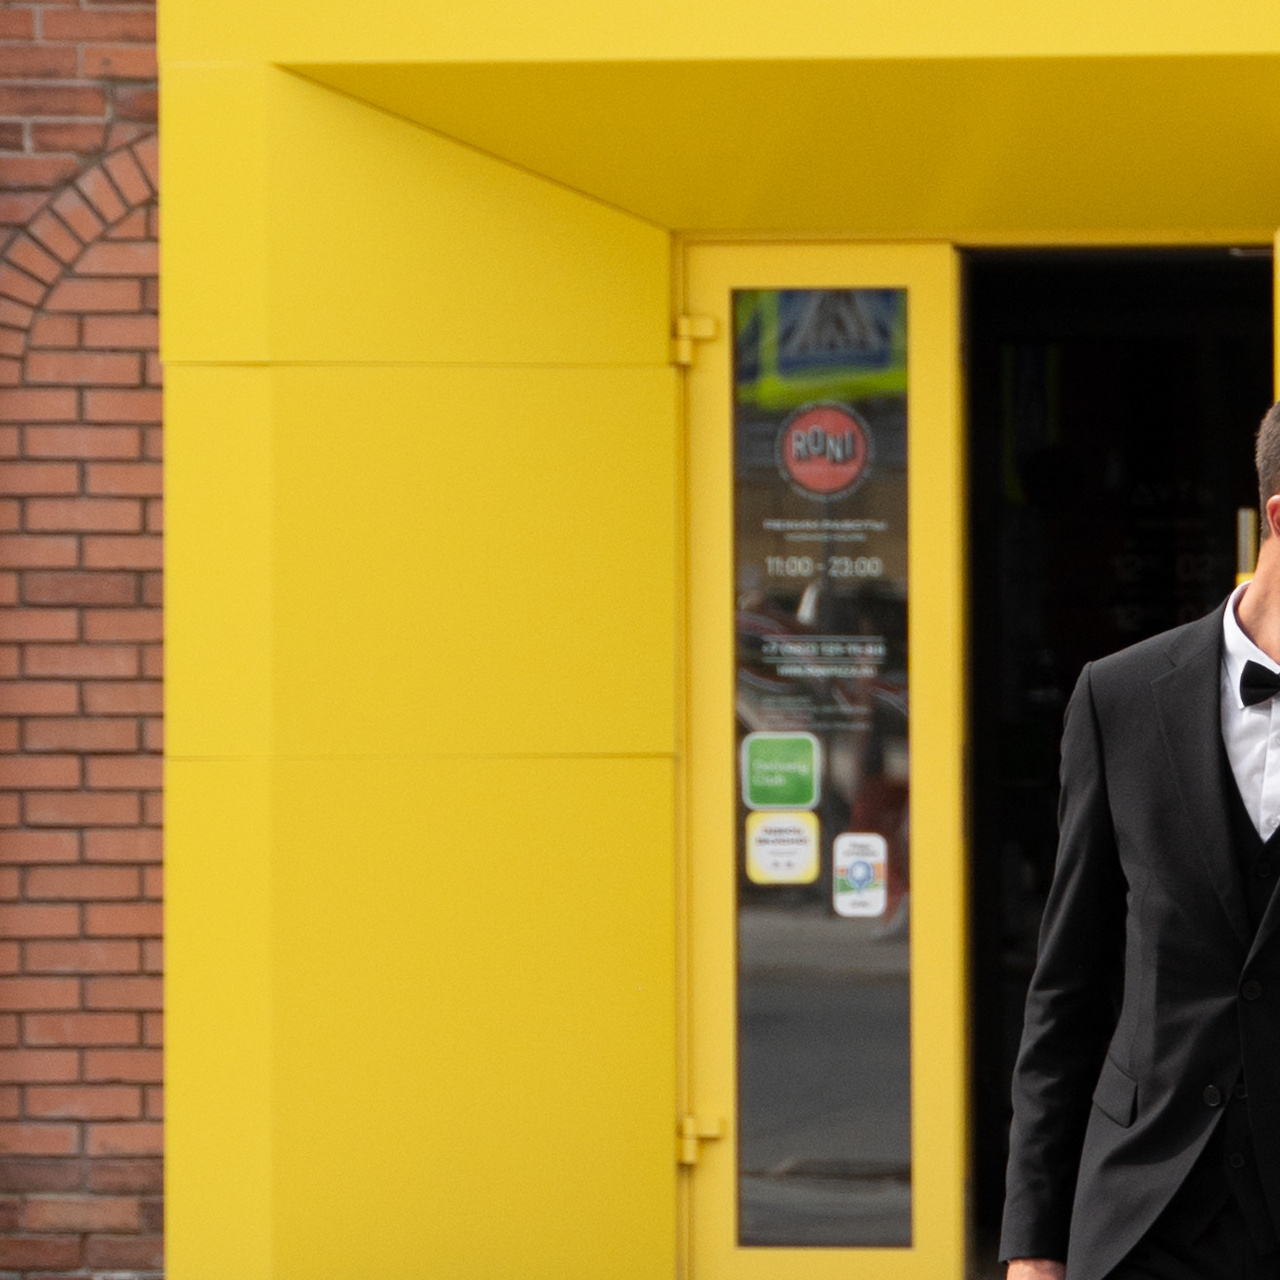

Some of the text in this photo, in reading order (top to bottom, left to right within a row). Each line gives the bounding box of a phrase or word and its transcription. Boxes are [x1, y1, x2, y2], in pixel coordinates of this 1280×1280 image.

[792, 425, 856, 462] RONI
[766, 556, 814, 577] 11:00
[828, 556, 883, 577] 23:00
